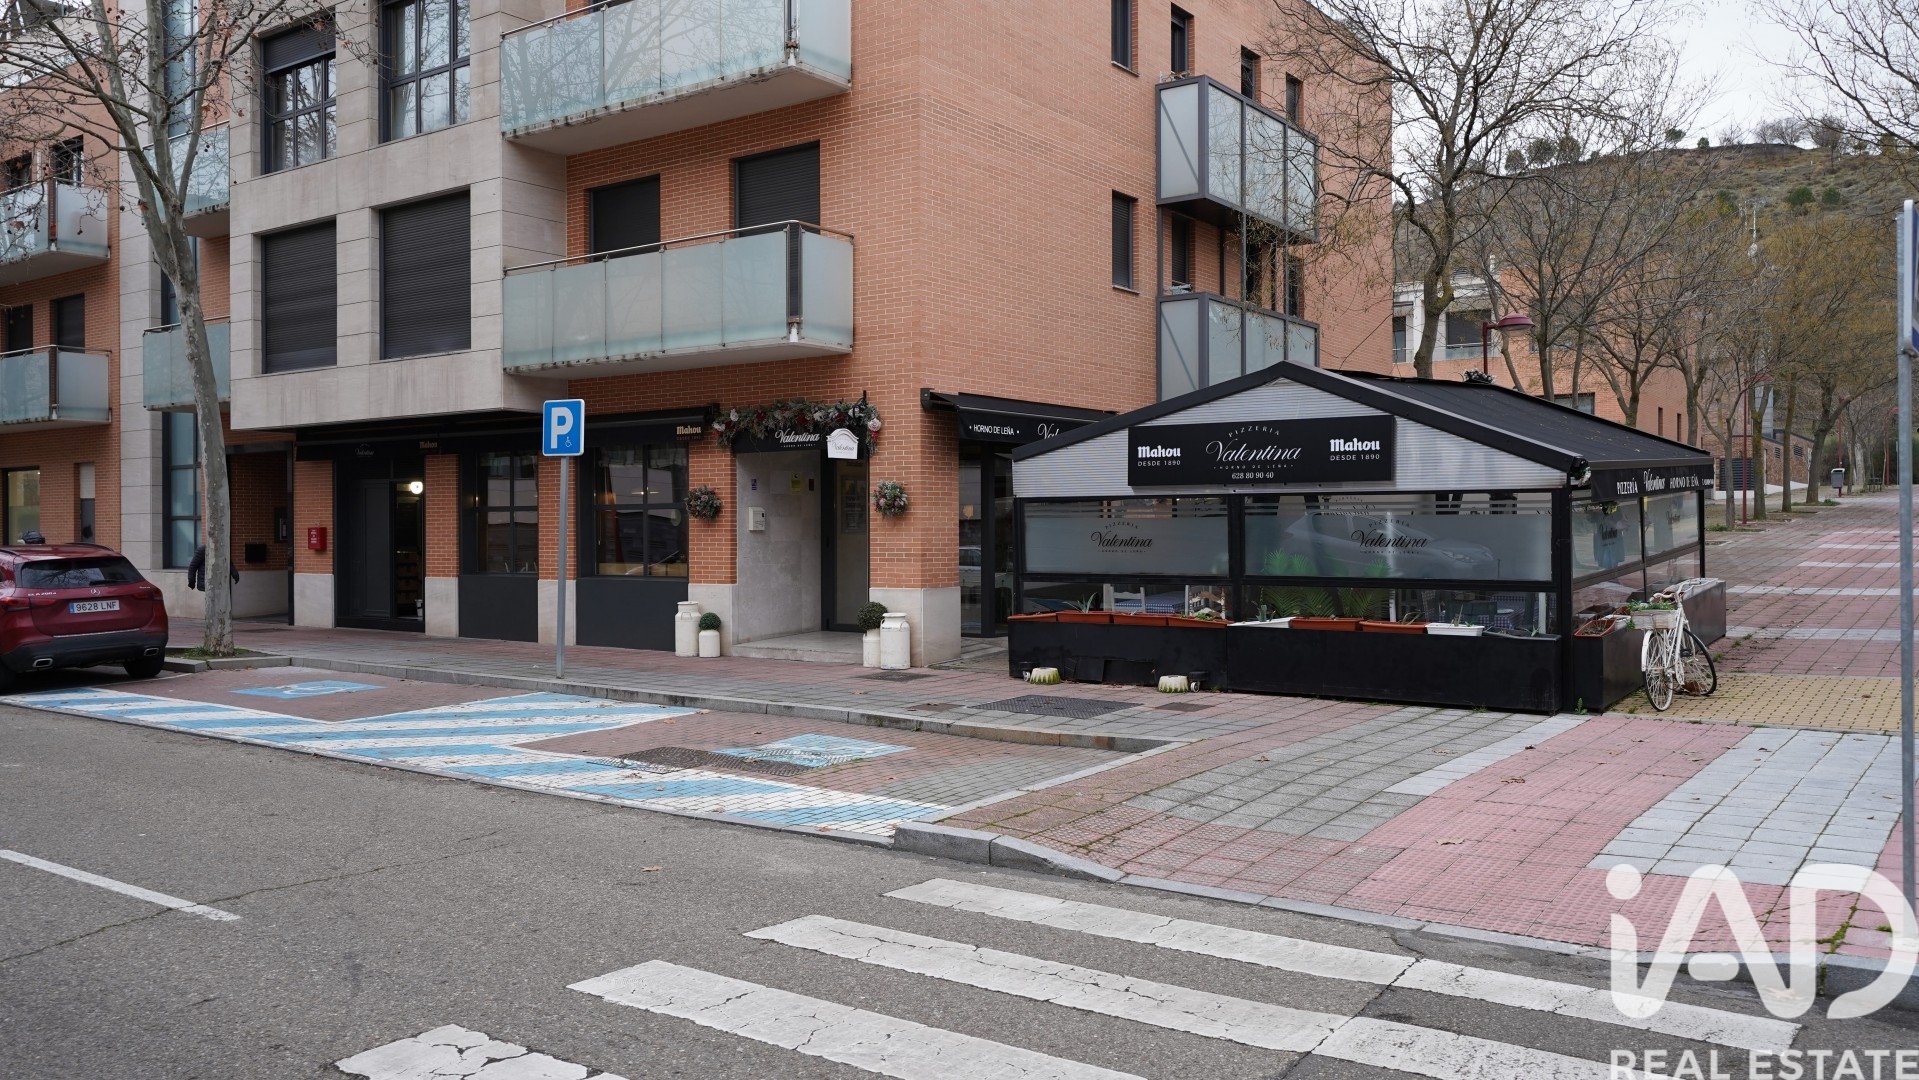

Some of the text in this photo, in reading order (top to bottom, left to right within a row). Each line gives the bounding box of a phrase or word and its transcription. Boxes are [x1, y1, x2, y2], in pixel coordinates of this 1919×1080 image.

[551, 407, 573, 448] P
[676, 426, 701, 434] Mahou
[973, 424, 1014, 435] HORNO DE LEÑA
[1228, 426, 1279, 437] PIZZERIA
[775, 428, 820, 443] Valentina
[1206, 438, 1302, 462] Valentina
[1330, 438, 1380, 451] Mahou
[1138, 445, 1181, 458] Mahou
[1091, 531, 1153, 547] Valentina
[1351, 529, 1428, 547] Valentina
[76, 601, 117, 612] 9628 LNF
